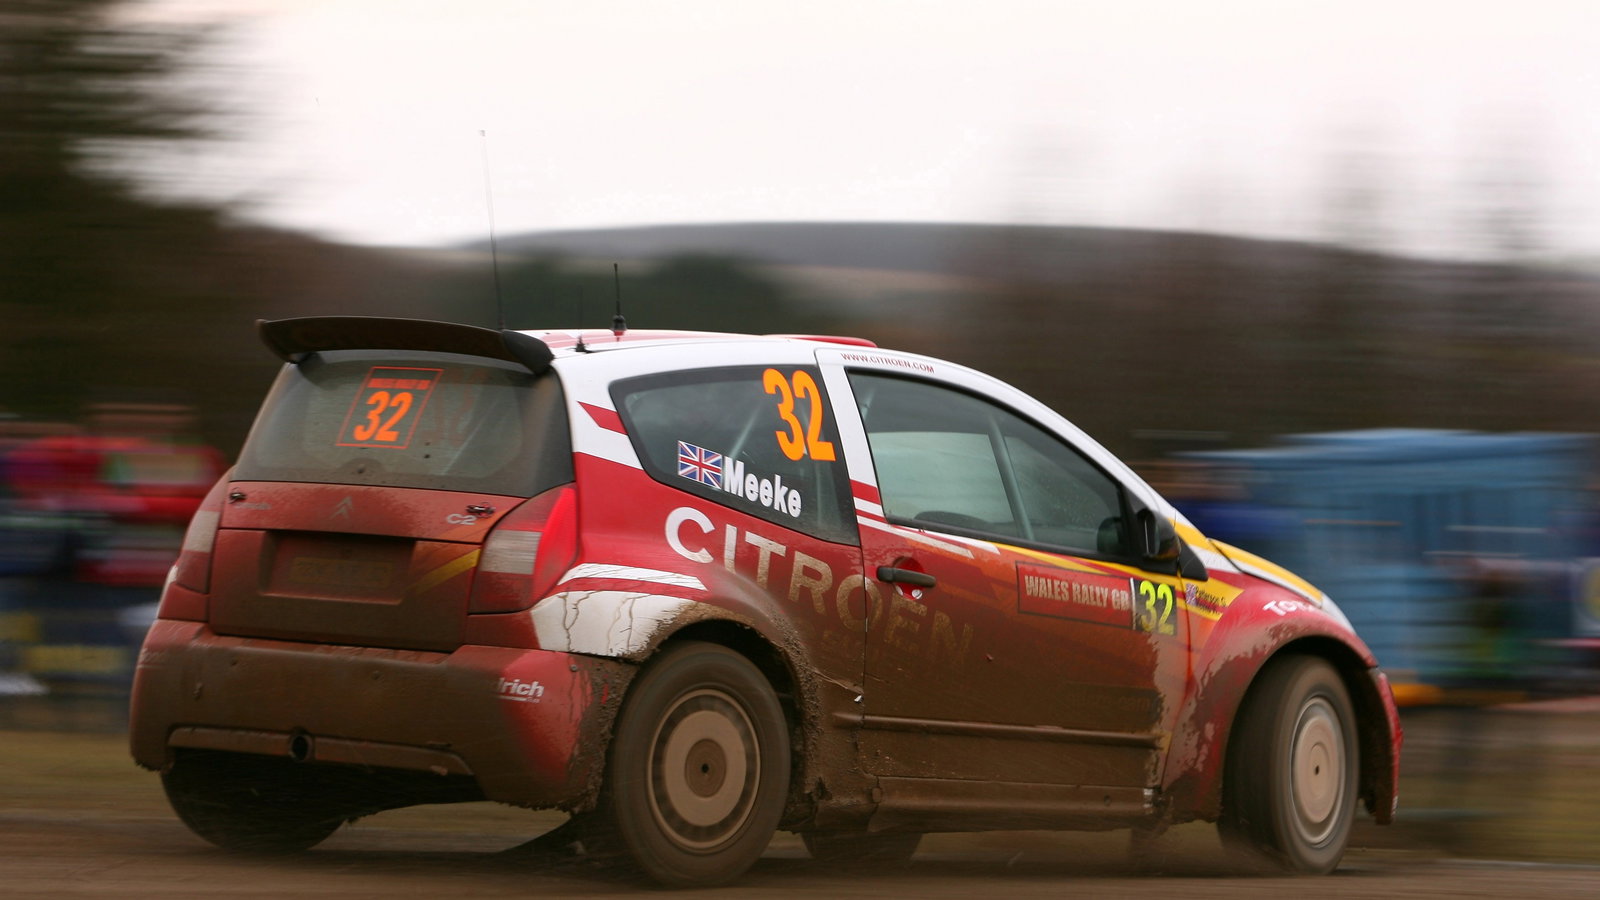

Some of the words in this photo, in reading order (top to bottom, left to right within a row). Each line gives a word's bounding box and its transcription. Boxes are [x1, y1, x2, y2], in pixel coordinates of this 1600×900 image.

[840, 352, 935, 374] WWW.CITROEN.COM
[353, 390, 413, 442] 32
[763, 368, 836, 461] 32
[723, 455, 802, 518] Meeke
[446, 513, 477, 526] C2
[1024, 575, 1070, 602] WALES
[1072, 583, 1109, 608] RALLY
[1111, 588, 1131, 611] GB
[1139, 580, 1175, 636] 32
